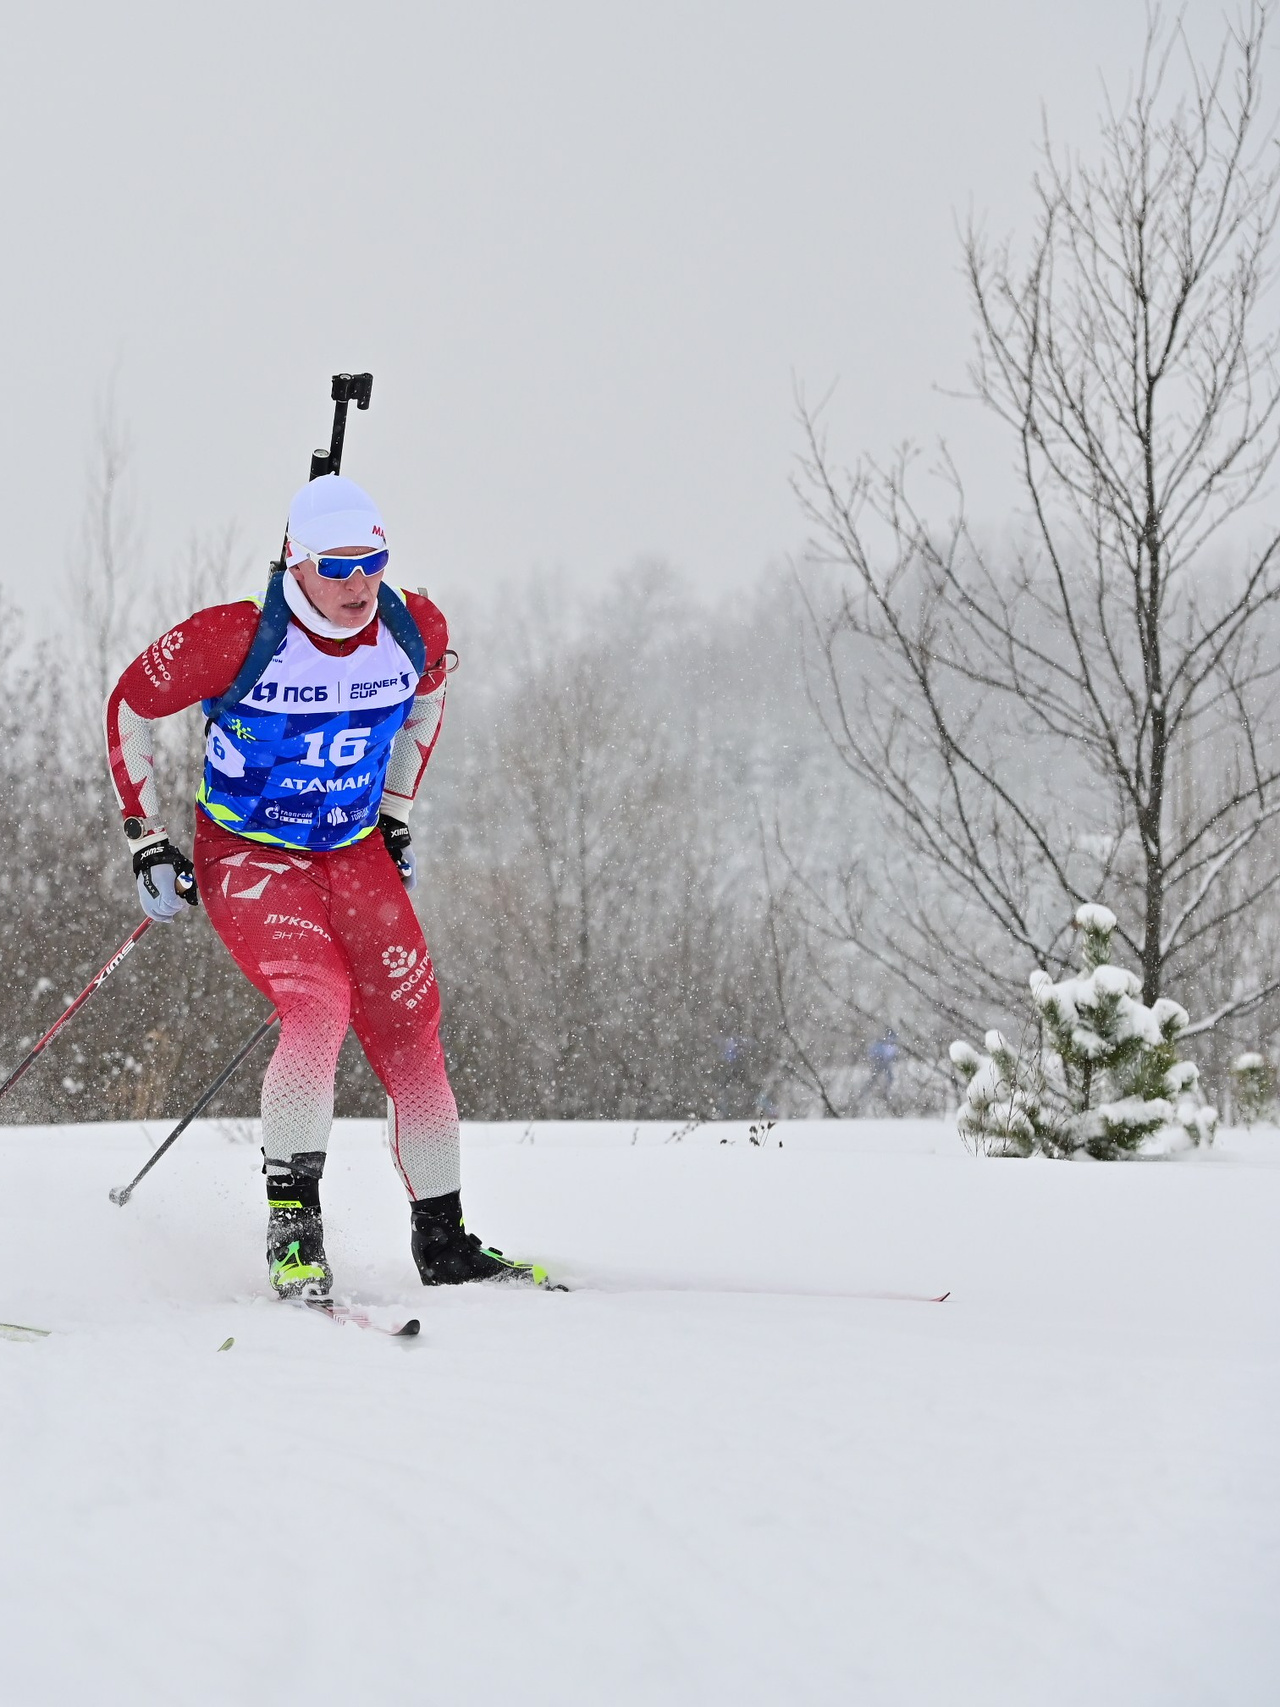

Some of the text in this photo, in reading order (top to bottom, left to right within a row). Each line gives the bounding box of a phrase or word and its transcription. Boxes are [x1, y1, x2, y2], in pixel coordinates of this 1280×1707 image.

[283, 685, 329, 703] ПСБ
[351, 678, 398, 692] PIONER
[350, 689, 378, 700] CUP
[299, 727, 372, 768] 16
[278, 772, 371, 796] АТАМАН
